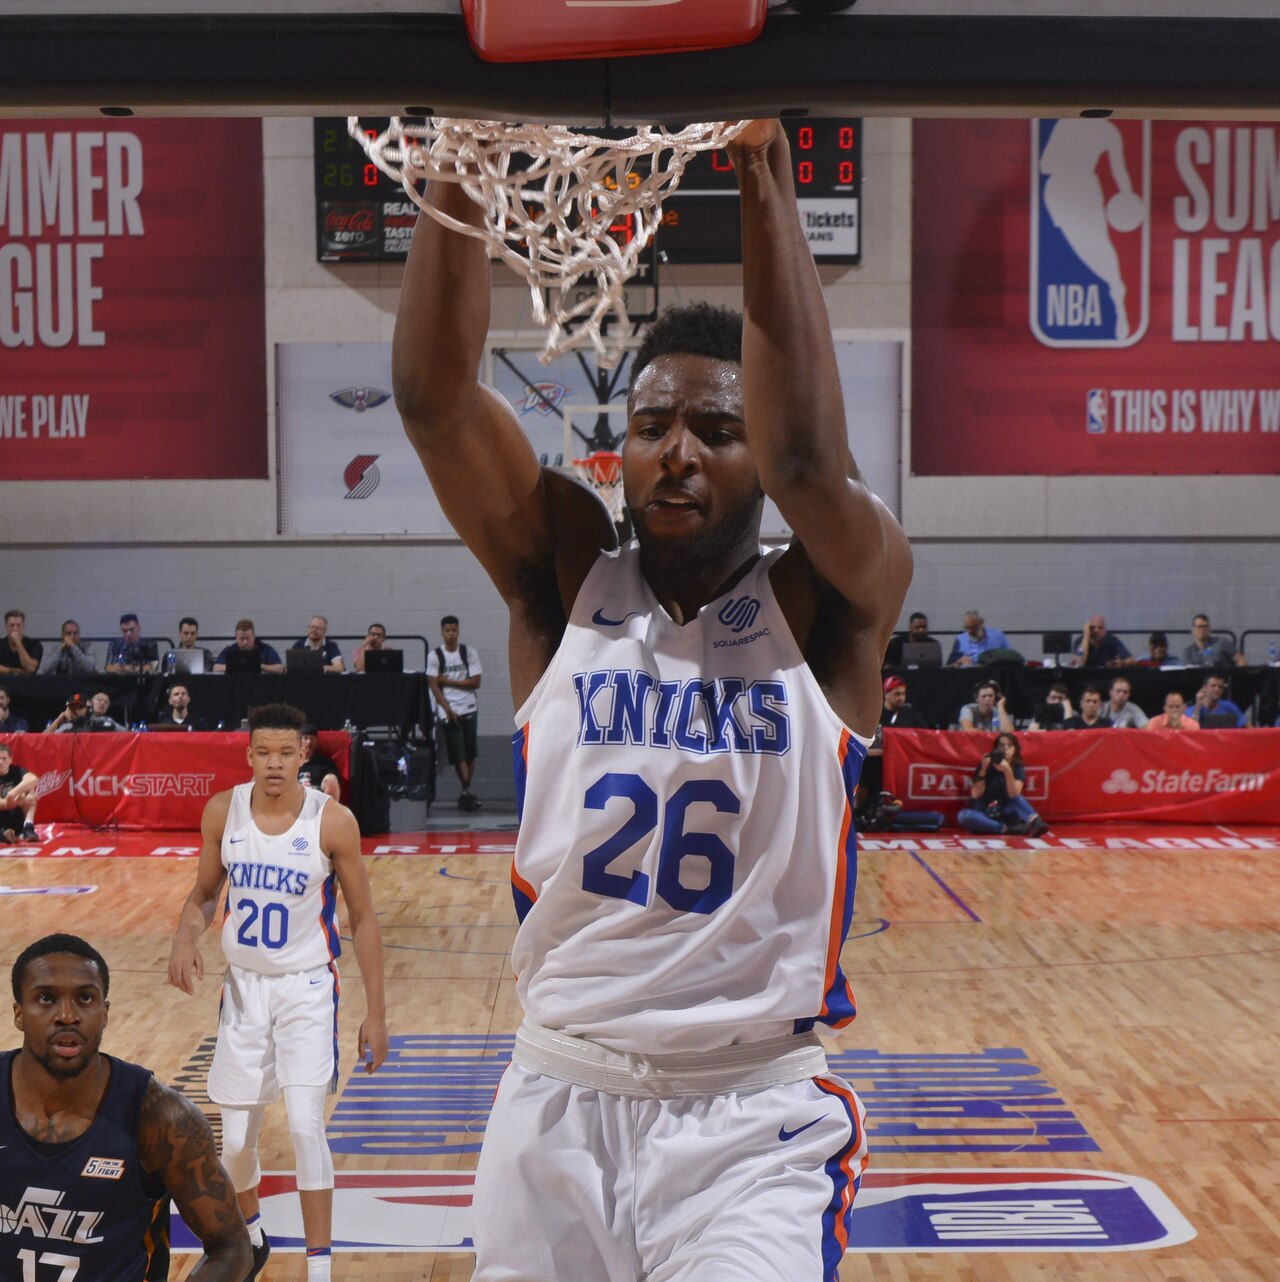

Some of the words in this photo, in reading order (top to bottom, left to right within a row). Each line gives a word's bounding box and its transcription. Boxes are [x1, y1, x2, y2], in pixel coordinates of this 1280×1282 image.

[798, 127, 814, 149] 0
[838, 127, 854, 149] 0
[798, 161, 814, 184] 0
[838, 161, 854, 184] 0
[334, 231, 365, 243] zero
[1046, 284, 1102, 327] NBA
[32, 395, 90, 438] PLAY
[1111, 390, 1166, 433] THIS
[1172, 390, 1196, 432] IS
[1200, 390, 1254, 432] WHY
[573, 668, 792, 757] KNICKS
[70, 768, 215, 797] KICKSTART
[582, 773, 741, 915] 26
[228, 861, 309, 896] KNICKS
[237, 898, 289, 949] 20
[86, 1160, 99, 1174] 5
[97, 1167, 120, 1177] FIGHT
[922, 1199, 1110, 1240] NBA
